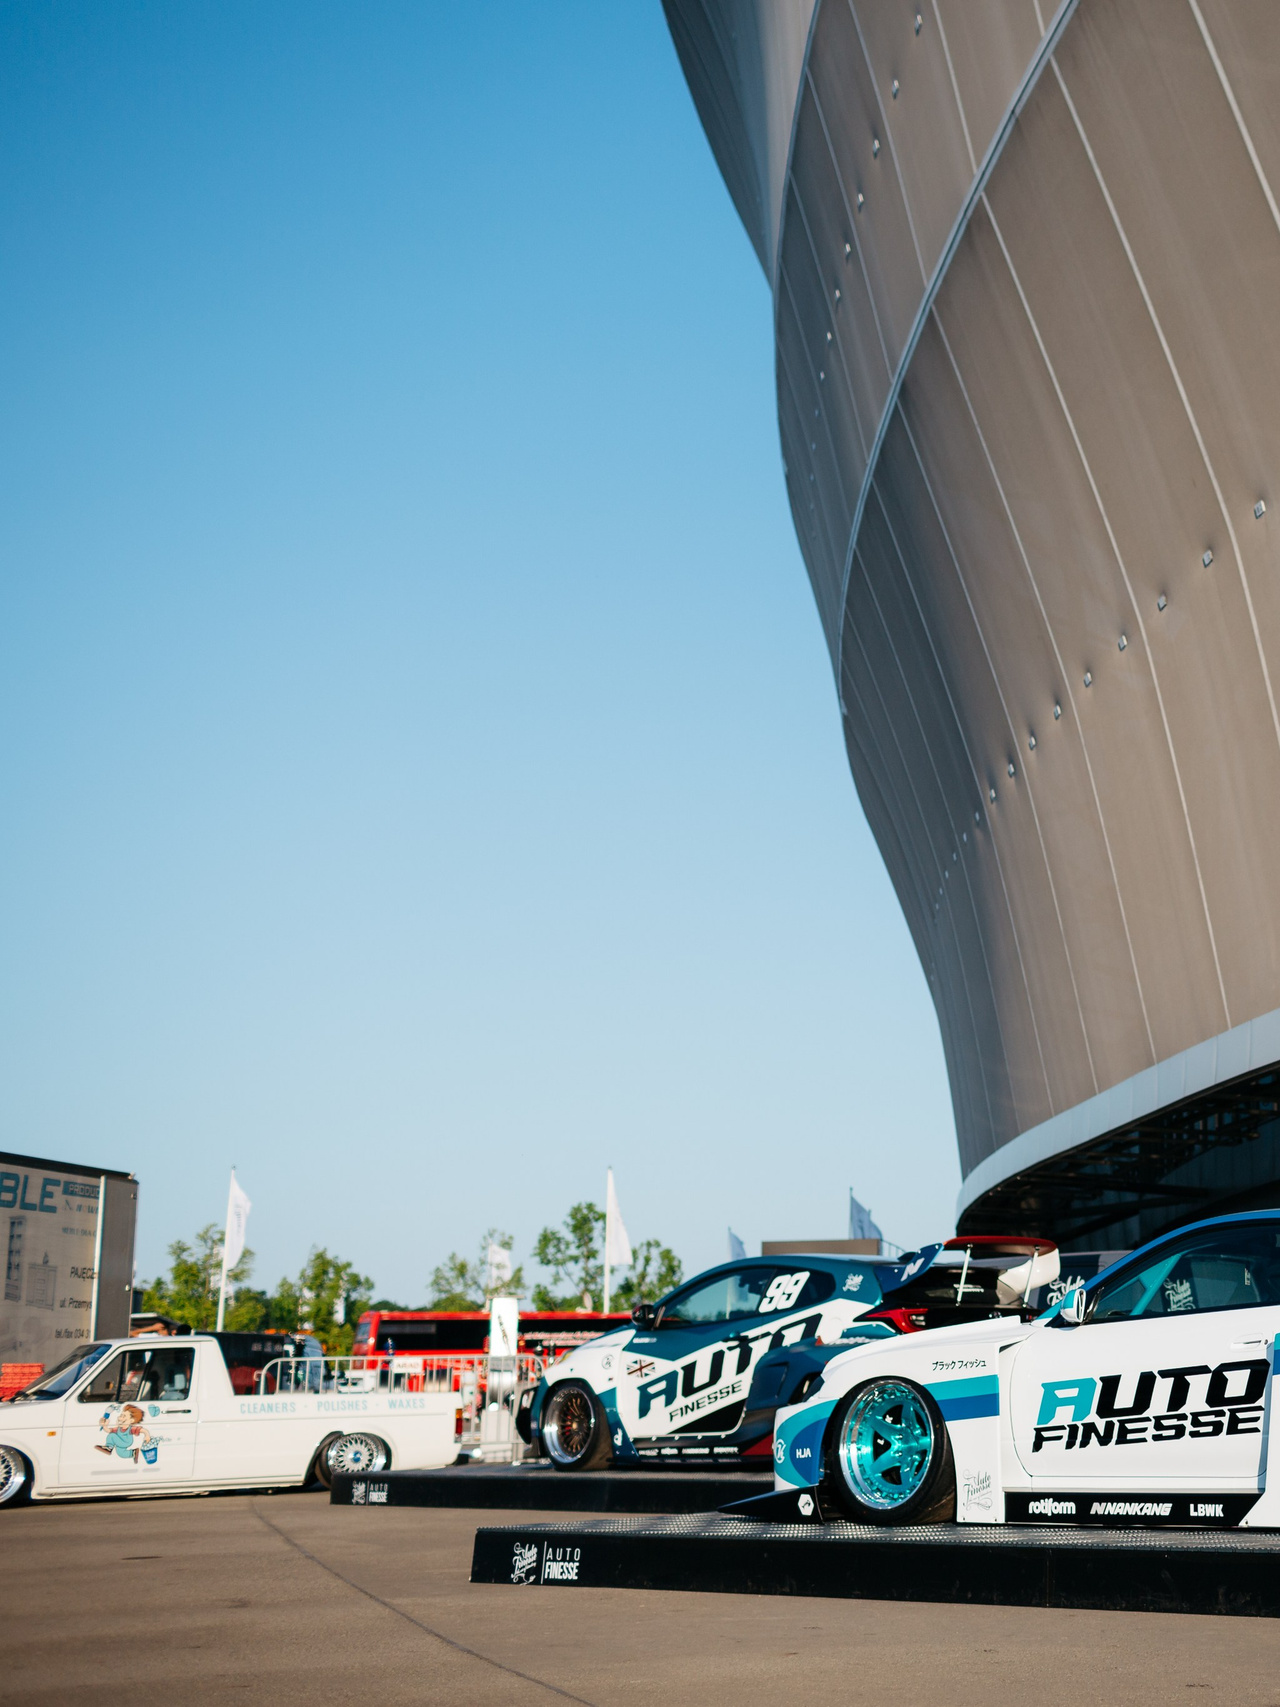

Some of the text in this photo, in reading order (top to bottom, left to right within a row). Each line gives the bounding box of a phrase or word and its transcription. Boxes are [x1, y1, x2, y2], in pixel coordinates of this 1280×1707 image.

[758, 1270, 811, 1313] 99
[638, 1313, 825, 1420] AUTO
[669, 1379, 743, 1423] FINESSE
[1037, 1358, 1271, 1426] AUTO
[240, 1398, 426, 1414] CLEANERS POLISHES WAXES
[1032, 1405, 1265, 1453] FINESSE
[796, 1447, 812, 1460] HJA
[370, 1483, 388, 1491] AUTO
[1029, 1498, 1076, 1517] rotiform
[1190, 1503, 1224, 1517] LBWK
[546, 1548, 581, 1561] AUTO
[545, 1562, 579, 1580] FINESSE
